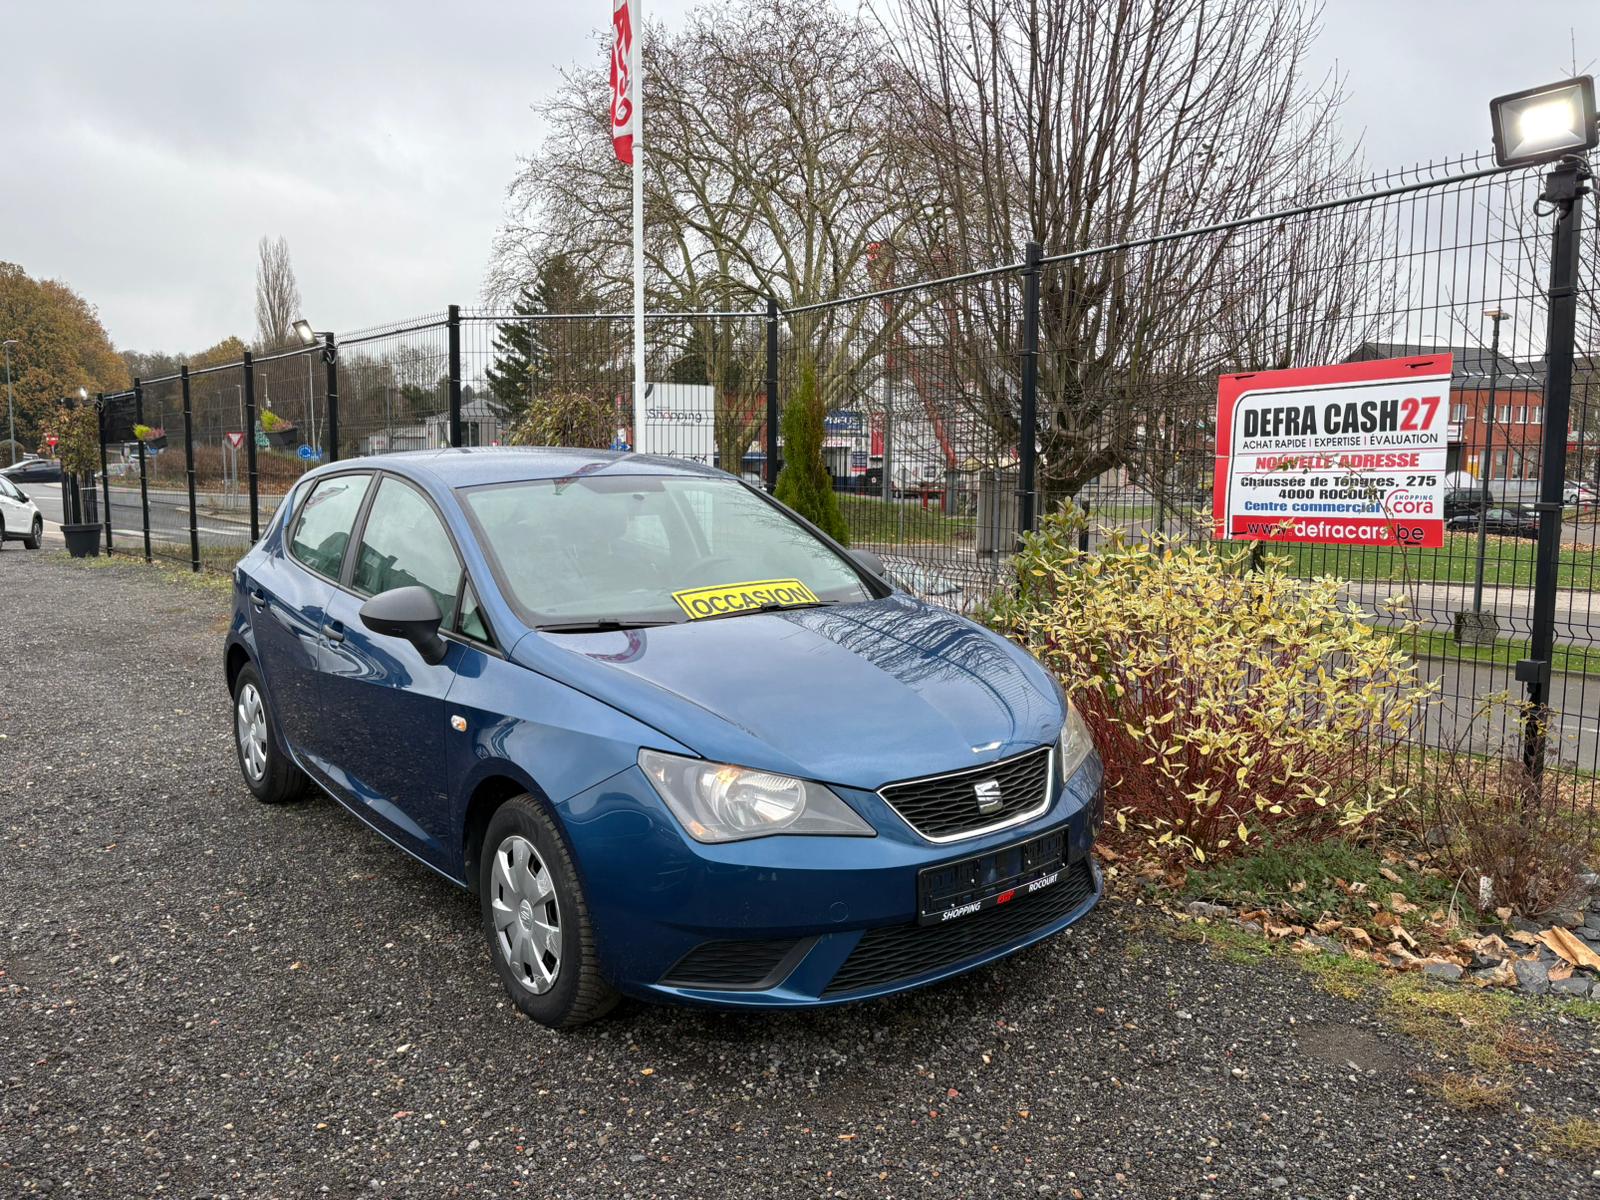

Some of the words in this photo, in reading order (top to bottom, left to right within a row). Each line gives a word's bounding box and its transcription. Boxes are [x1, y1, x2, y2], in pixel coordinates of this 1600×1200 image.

[1244, 405, 1317, 437] DEFRA
[1243, 440, 1273, 449] ACHAT
[1275, 438, 1307, 448] RAPIDE
[1315, 436, 1361, 447] EXPERTISE
[1370, 433, 1438, 446] ÉVALUATION
[1255, 454, 1334, 469] NOUVELLE
[1338, 453, 1420, 468] ADRESSE
[1241, 476, 1306, 487] Chaussée
[1310, 476, 1329, 487] de
[1406, 475, 1437, 487] 275
[1279, 489, 1315, 499] 4000
[1244, 500, 1288, 511] Centre
[1292, 502, 1381, 513] commercial
[1393, 500, 1433, 514] cora
[691, 586, 811, 616] OCCASION
[941, 901, 982, 922] SHOPPING
[1028, 873, 1058, 893] ROCOURT
